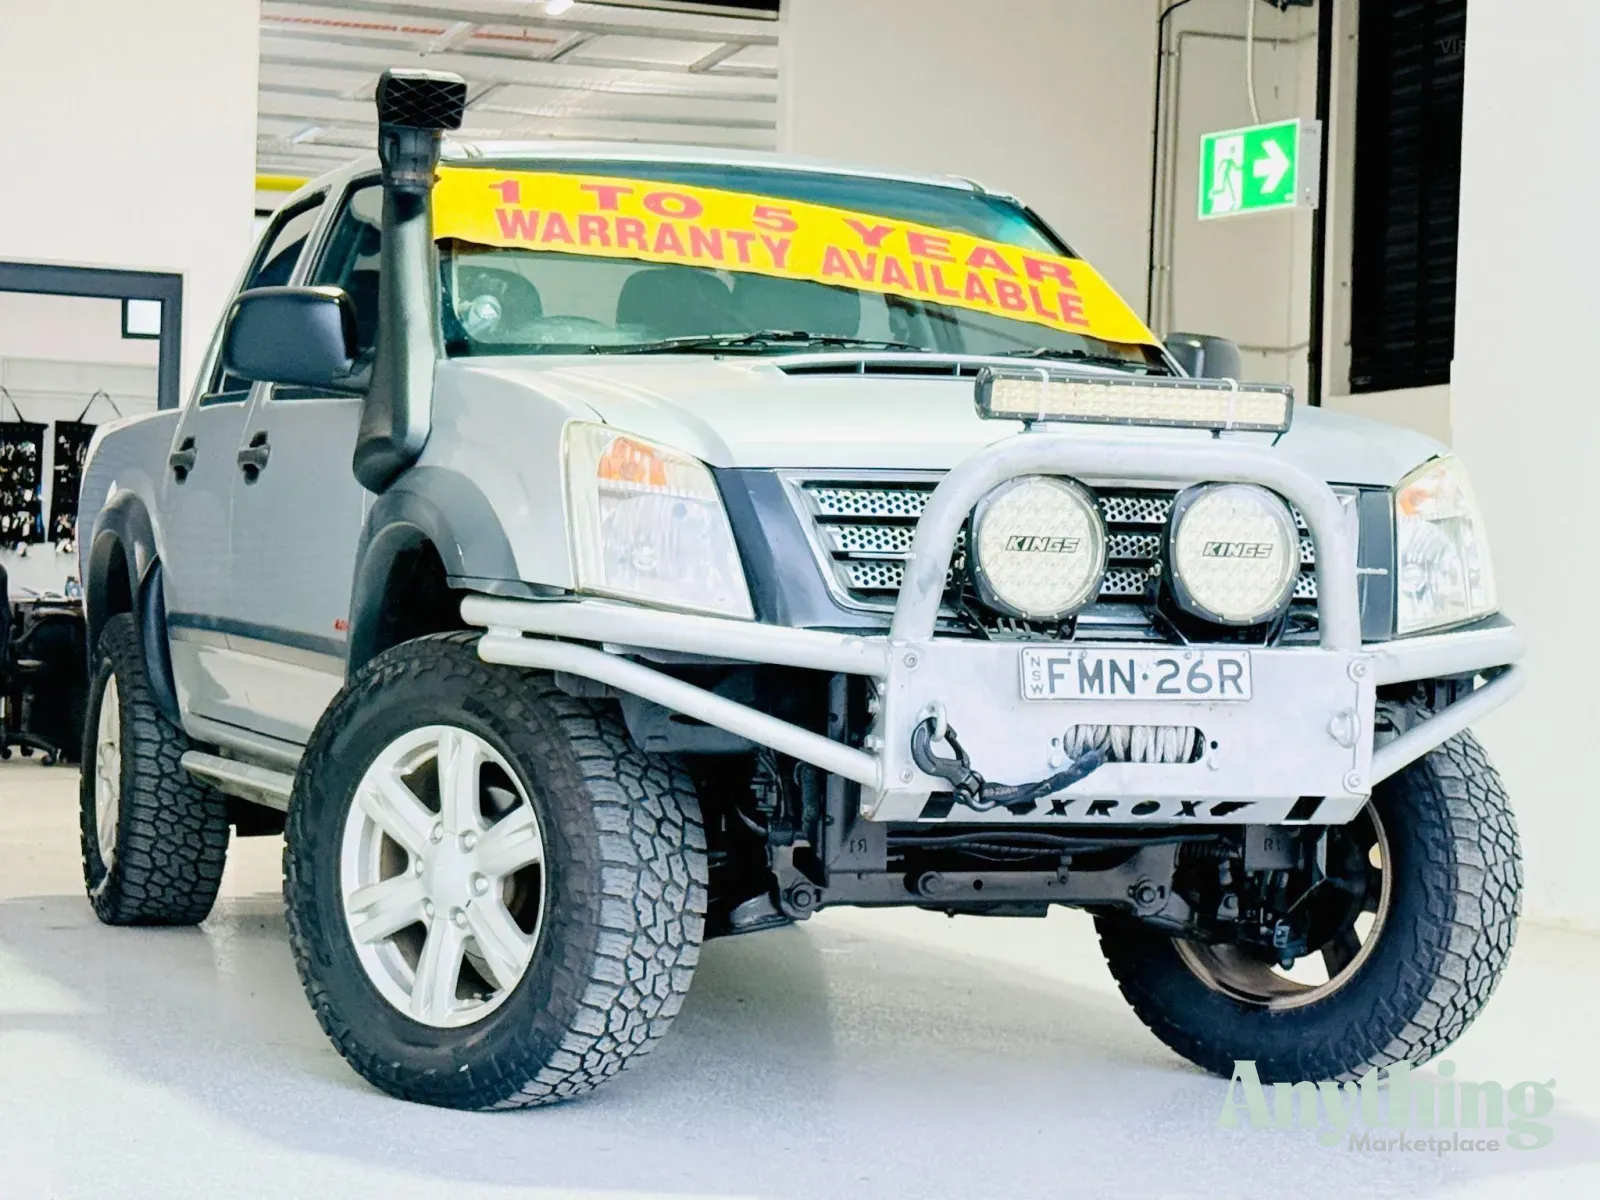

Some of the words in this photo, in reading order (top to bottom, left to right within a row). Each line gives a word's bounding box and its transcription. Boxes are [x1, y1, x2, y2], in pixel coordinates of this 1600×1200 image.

[488, 180, 520, 204] 1
[580, 184, 703, 219] TO
[752, 205, 799, 233] 5
[843, 218, 1078, 290] YEAR
[495, 209, 792, 269] WARRANTY
[822, 246, 1090, 327] AVAILABLE
[1005, 535, 1080, 553] KINGS
[1202, 541, 1273, 558] KINGS
[1044, 799, 1206, 817] XROX
